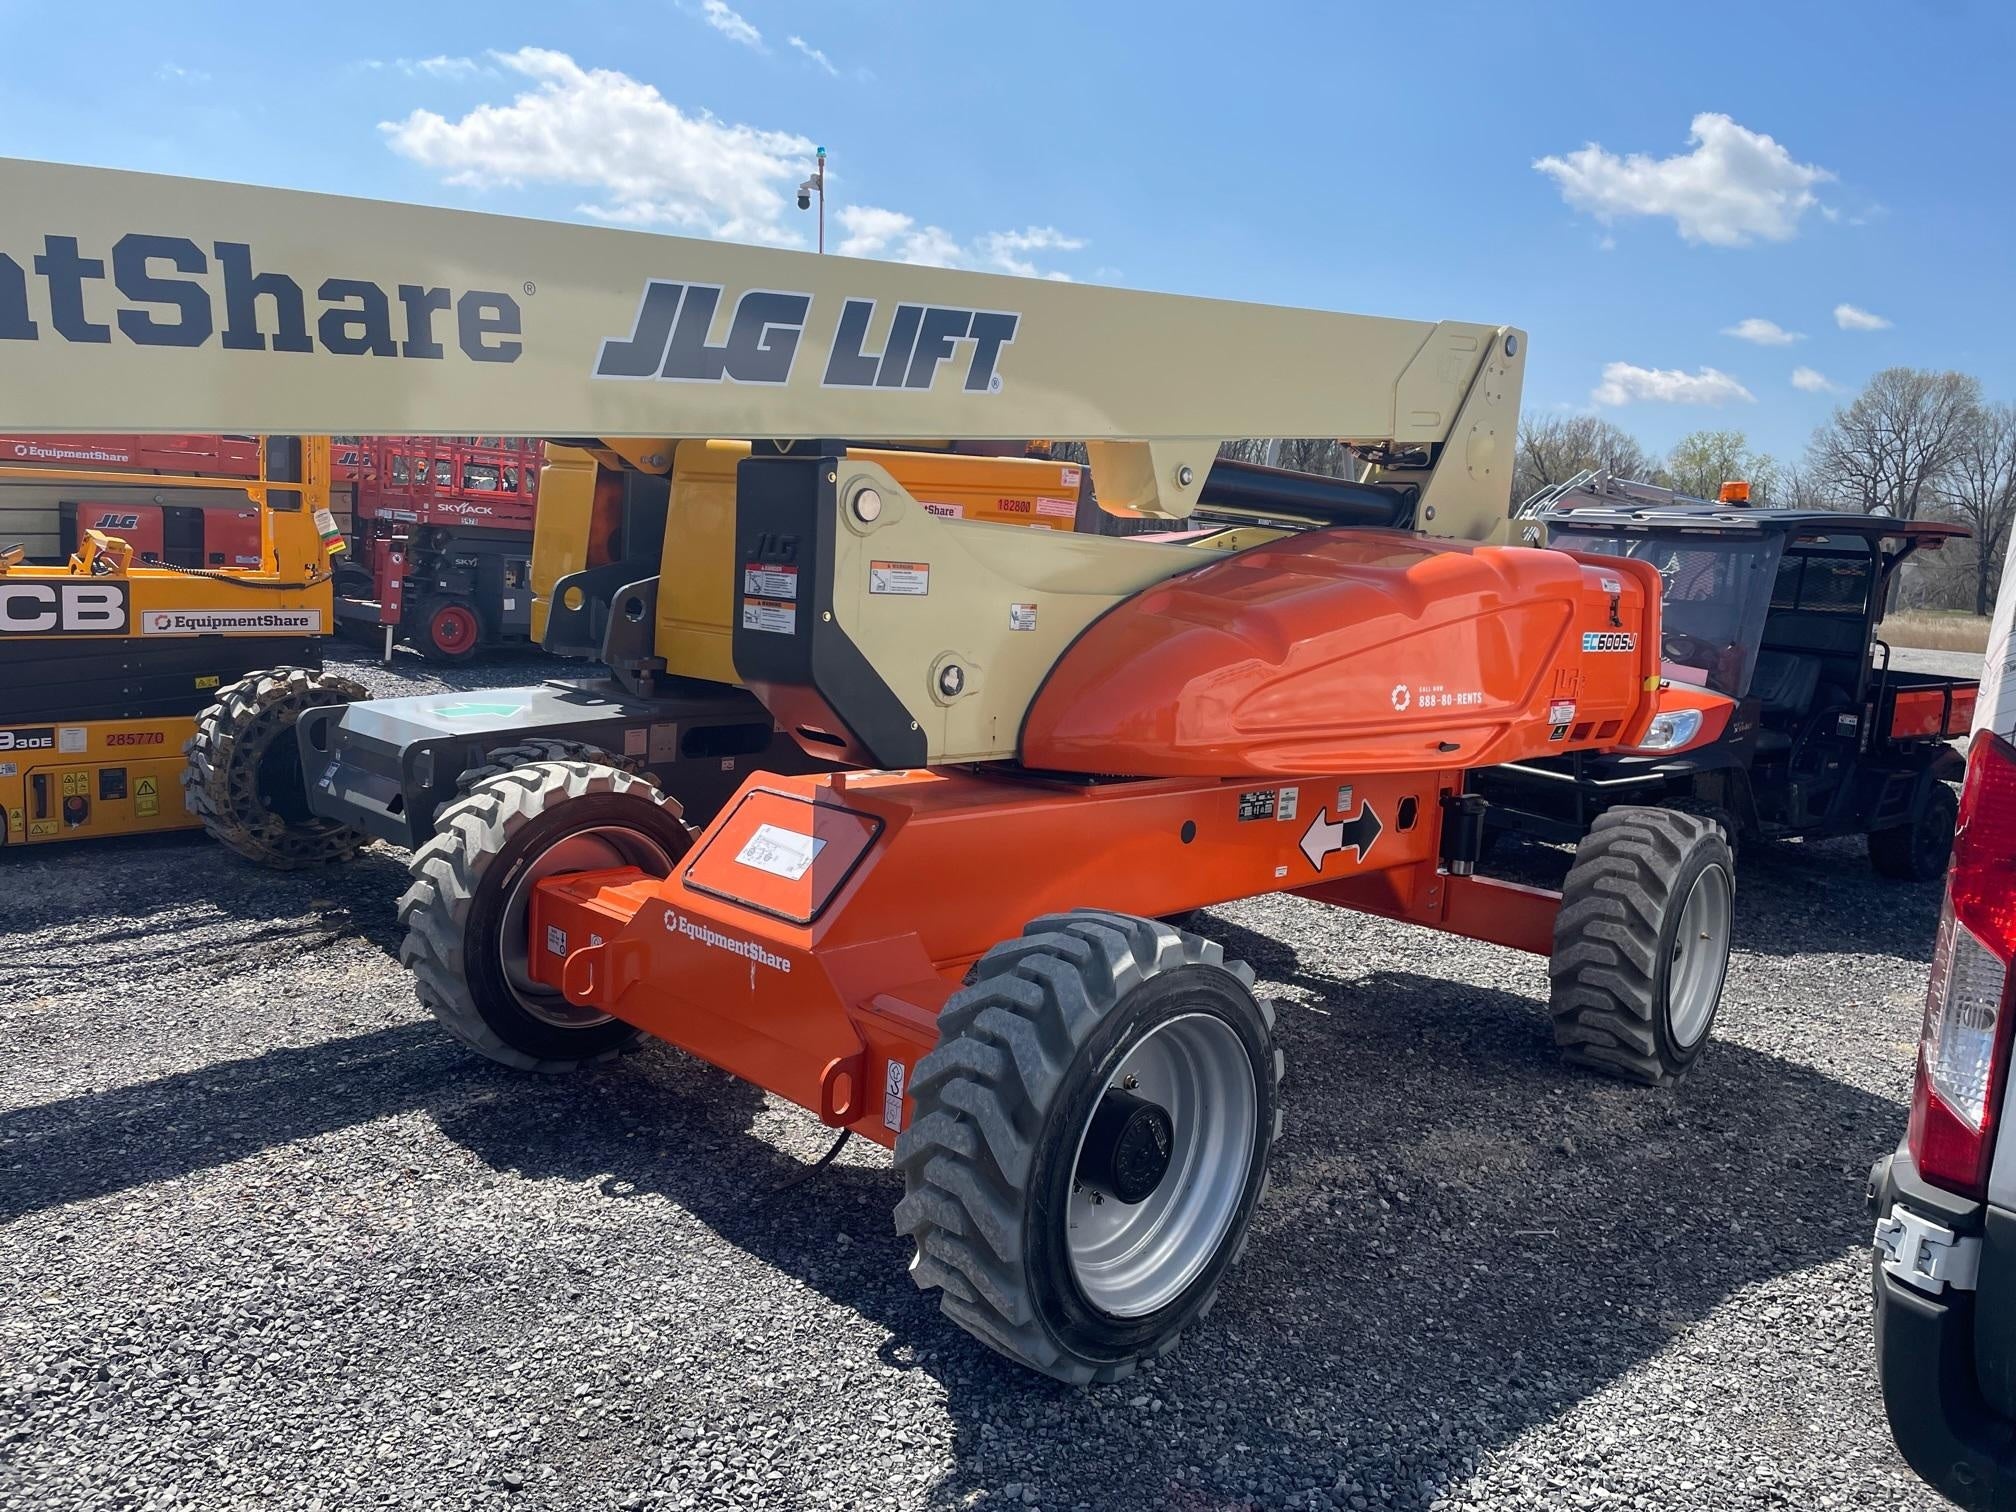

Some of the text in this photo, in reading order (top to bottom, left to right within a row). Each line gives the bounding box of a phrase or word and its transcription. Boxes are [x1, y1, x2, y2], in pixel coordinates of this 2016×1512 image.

[591, 278, 1022, 393] JLG LIFT
[29, 446, 129, 462] EquipmentShare
[437, 502, 493, 515] SKYJACK
[998, 499, 1031, 513] 182800
[94, 513, 139, 530] JLG
[175, 614, 309, 629] EquipmentShare
[1583, 632, 1637, 652] EC600SJ
[1419, 692, 1482, 708] 888-80-RENTS
[106, 732, 164, 746] 285770
[677, 915, 791, 973] EquipmentShare
